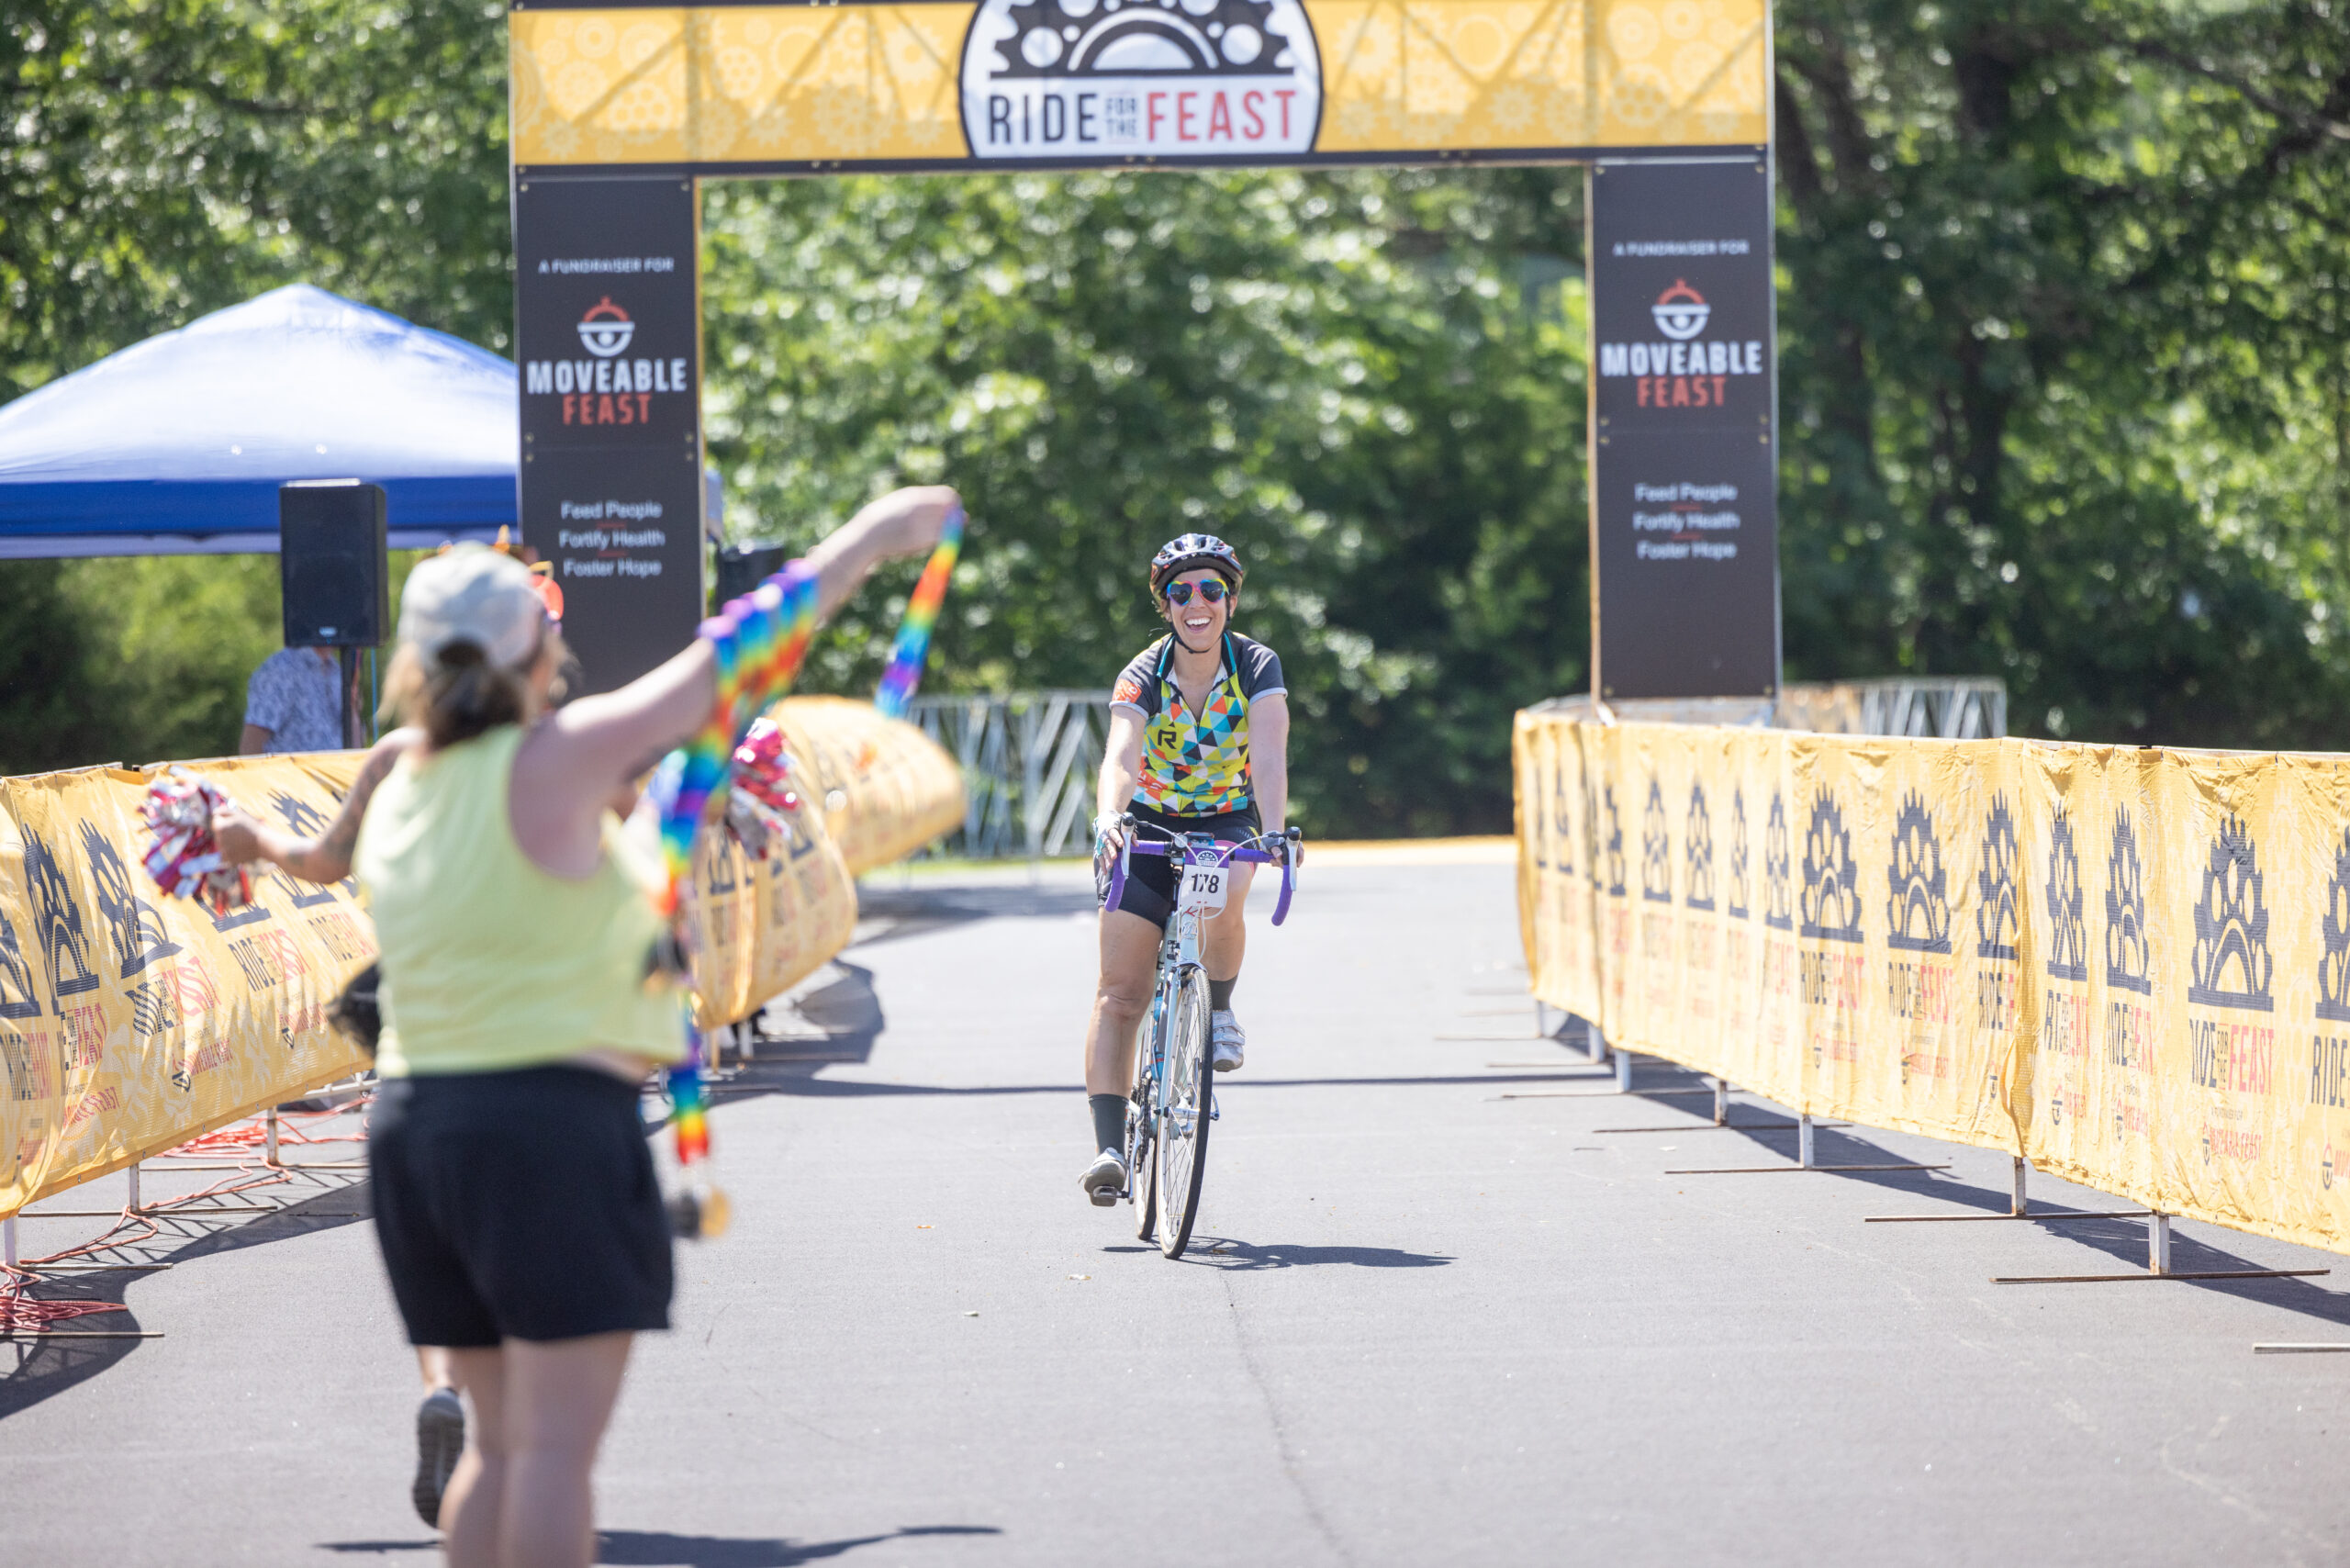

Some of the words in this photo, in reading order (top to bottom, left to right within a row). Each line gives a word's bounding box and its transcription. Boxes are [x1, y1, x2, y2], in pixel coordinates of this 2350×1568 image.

[990, 93, 1098, 144] RIDE
[1106, 97, 1137, 116] FOR
[1147, 90, 1296, 142] FEAST
[1106, 119, 1137, 139] THE
[1613, 241, 1625, 256] A
[1626, 240, 1717, 256] FUNDRAISER
[1718, 239, 1750, 255] FOR
[538, 259, 550, 274] A
[552, 257, 642, 274] FUNDRAISER
[643, 257, 674, 273] FOR
[1601, 341, 1762, 376] MOVEABLE
[526, 358, 688, 394] MOVEABLE
[1637, 376, 1726, 408] FEAST
[562, 394, 652, 425] FEAST
[1635, 483, 1677, 502] Feed
[1680, 482, 1738, 502] People
[561, 500, 602, 519] Feed
[607, 500, 663, 521] People
[1633, 511, 1684, 532] Fortify
[1686, 511, 1740, 530] Health
[559, 528, 610, 551] Fortify
[612, 528, 666, 547] Health
[1637, 540, 1690, 559] Foster
[1692, 541, 1738, 562] Hope
[564, 557, 615, 577] Foster
[619, 558, 663, 579] Hope
[1192, 873, 1219, 894] 178
[229, 936, 276, 992] RIDE
[1888, 961, 1913, 1019] RIDE
[2188, 1018, 2217, 1089] IDE
[2217, 1030, 2229, 1056] FOR
[2228, 1024, 2275, 1096] FEAST
[2311, 1036, 2349, 1109] RIDE
